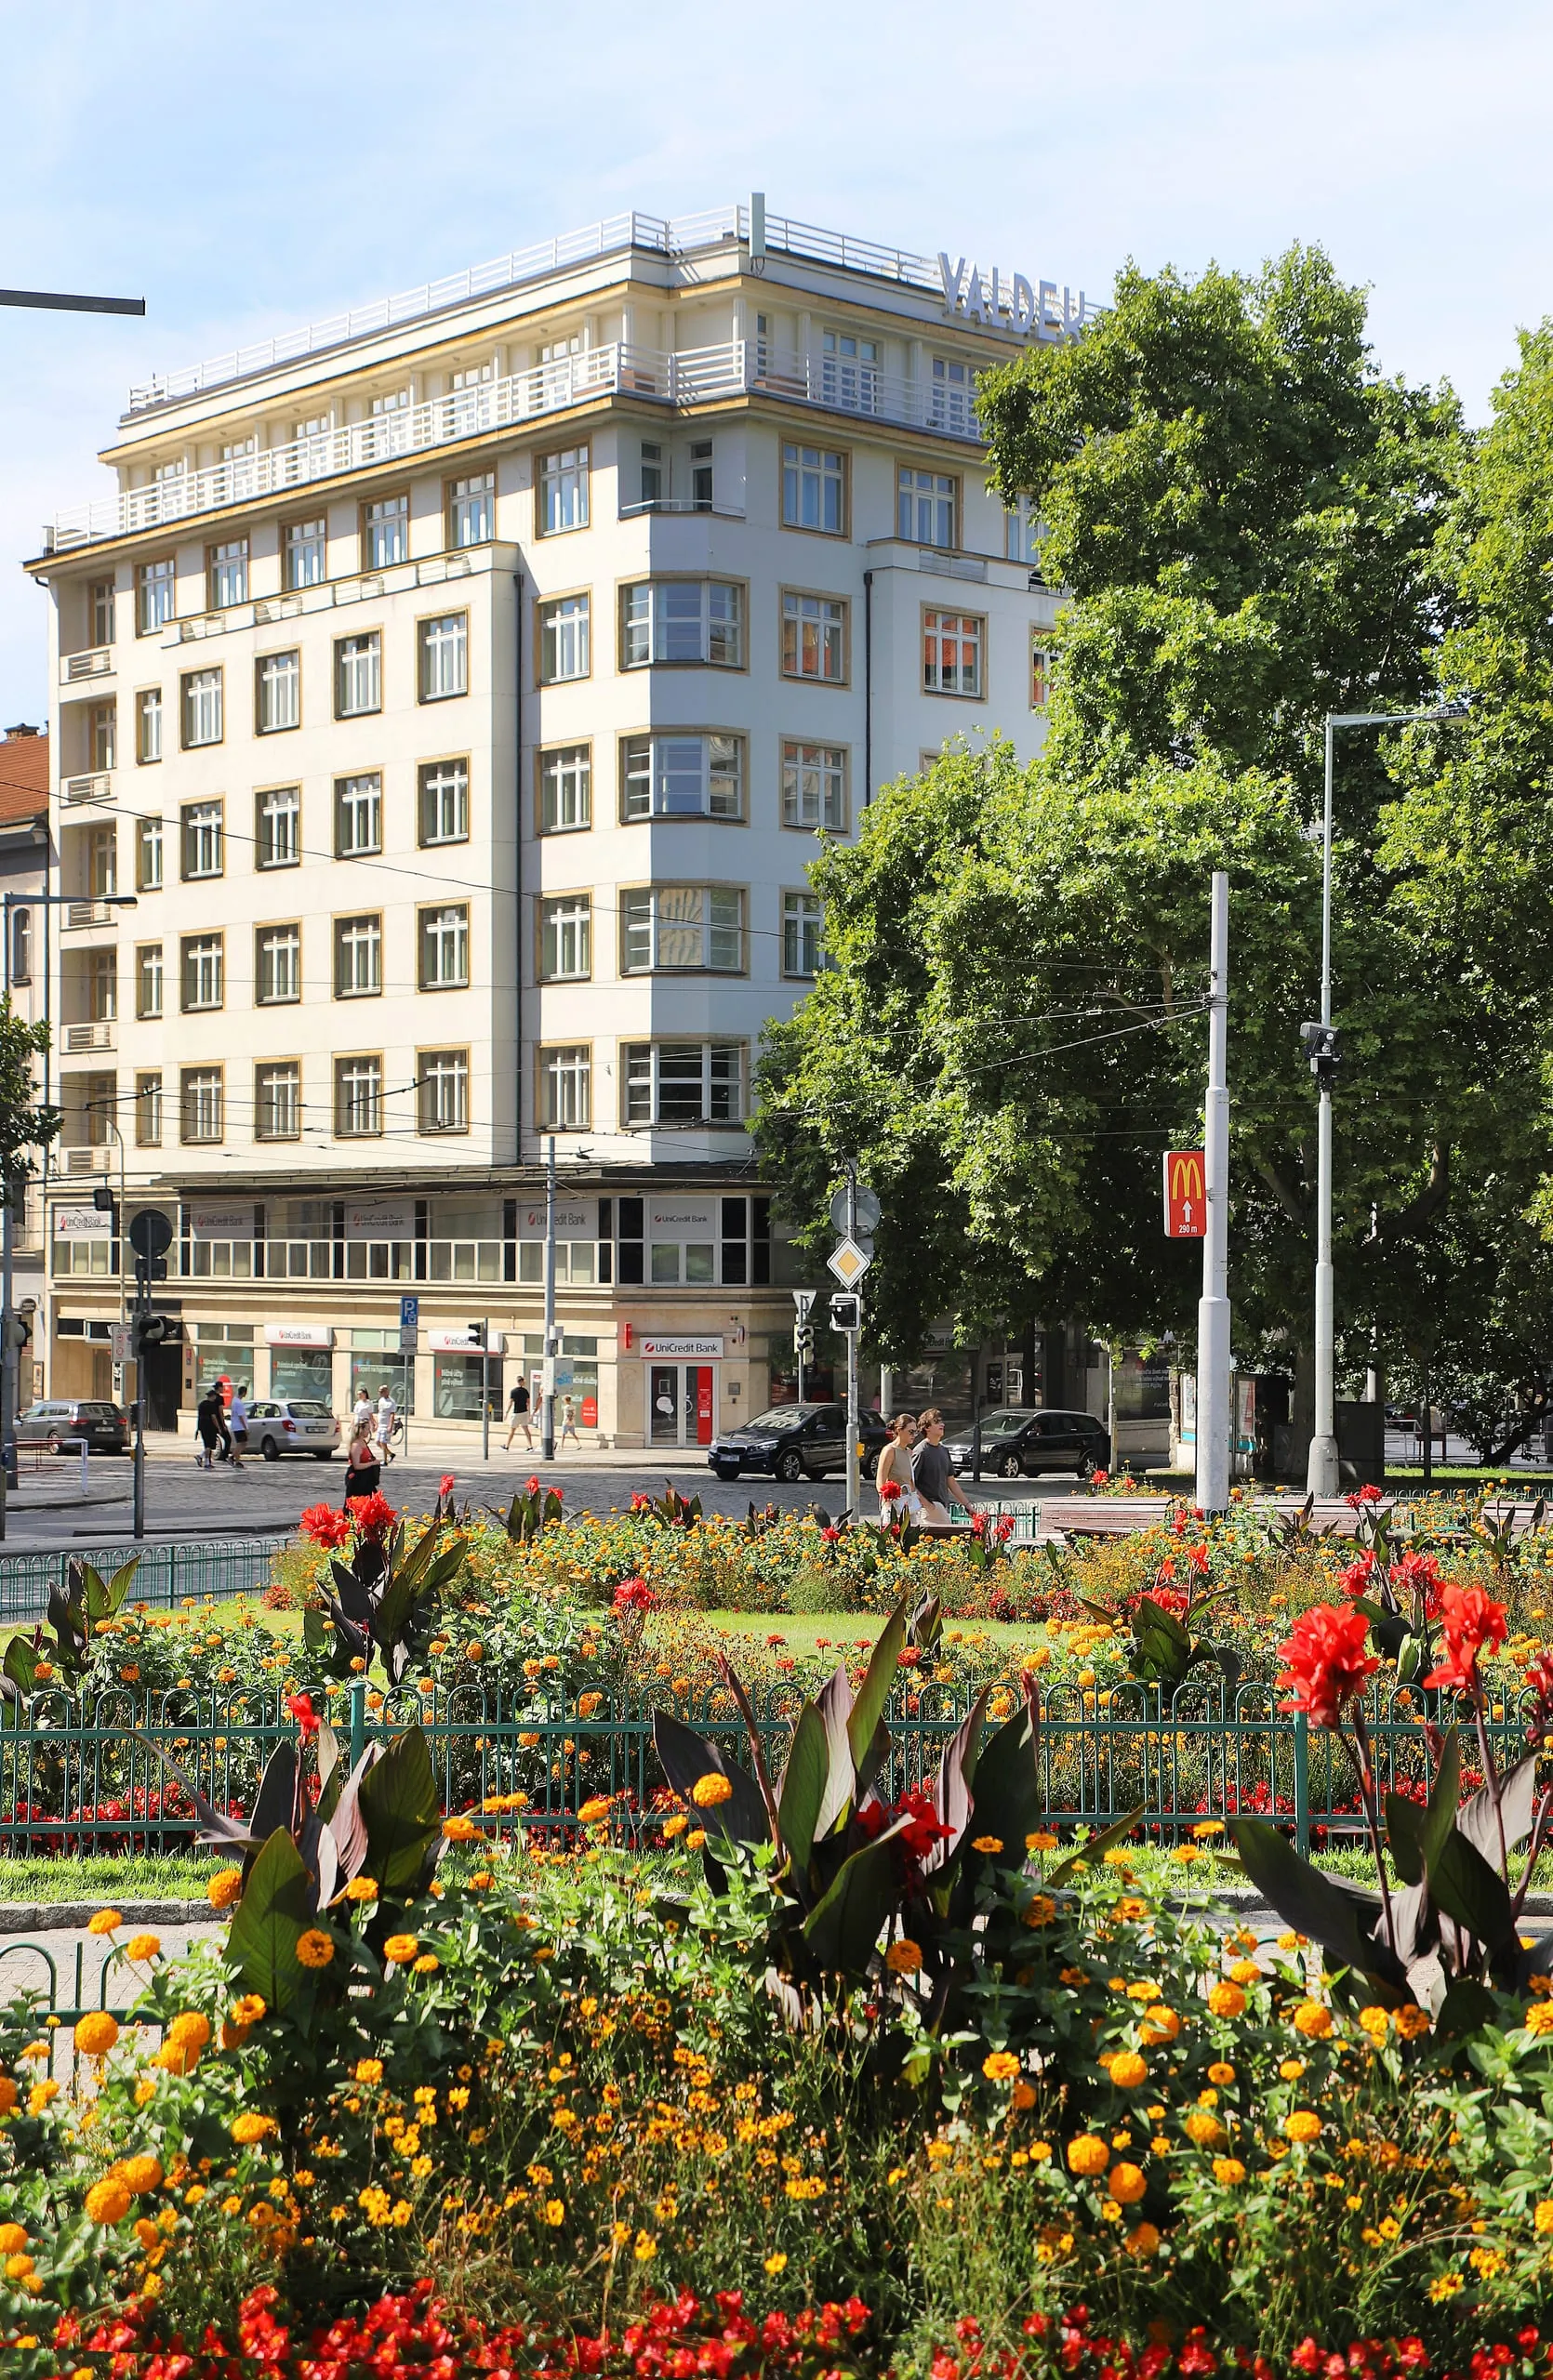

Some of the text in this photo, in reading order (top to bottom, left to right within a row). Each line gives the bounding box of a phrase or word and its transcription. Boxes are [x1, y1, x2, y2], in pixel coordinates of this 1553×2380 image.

[568, 1212, 586, 1225] Bank
[662, 1215, 708, 1223] UniCredit Bank
[1178, 1224, 1190, 1234] 290
[405, 1301, 415, 1316] P
[656, 1342, 718, 1353] UniCredit Bank
